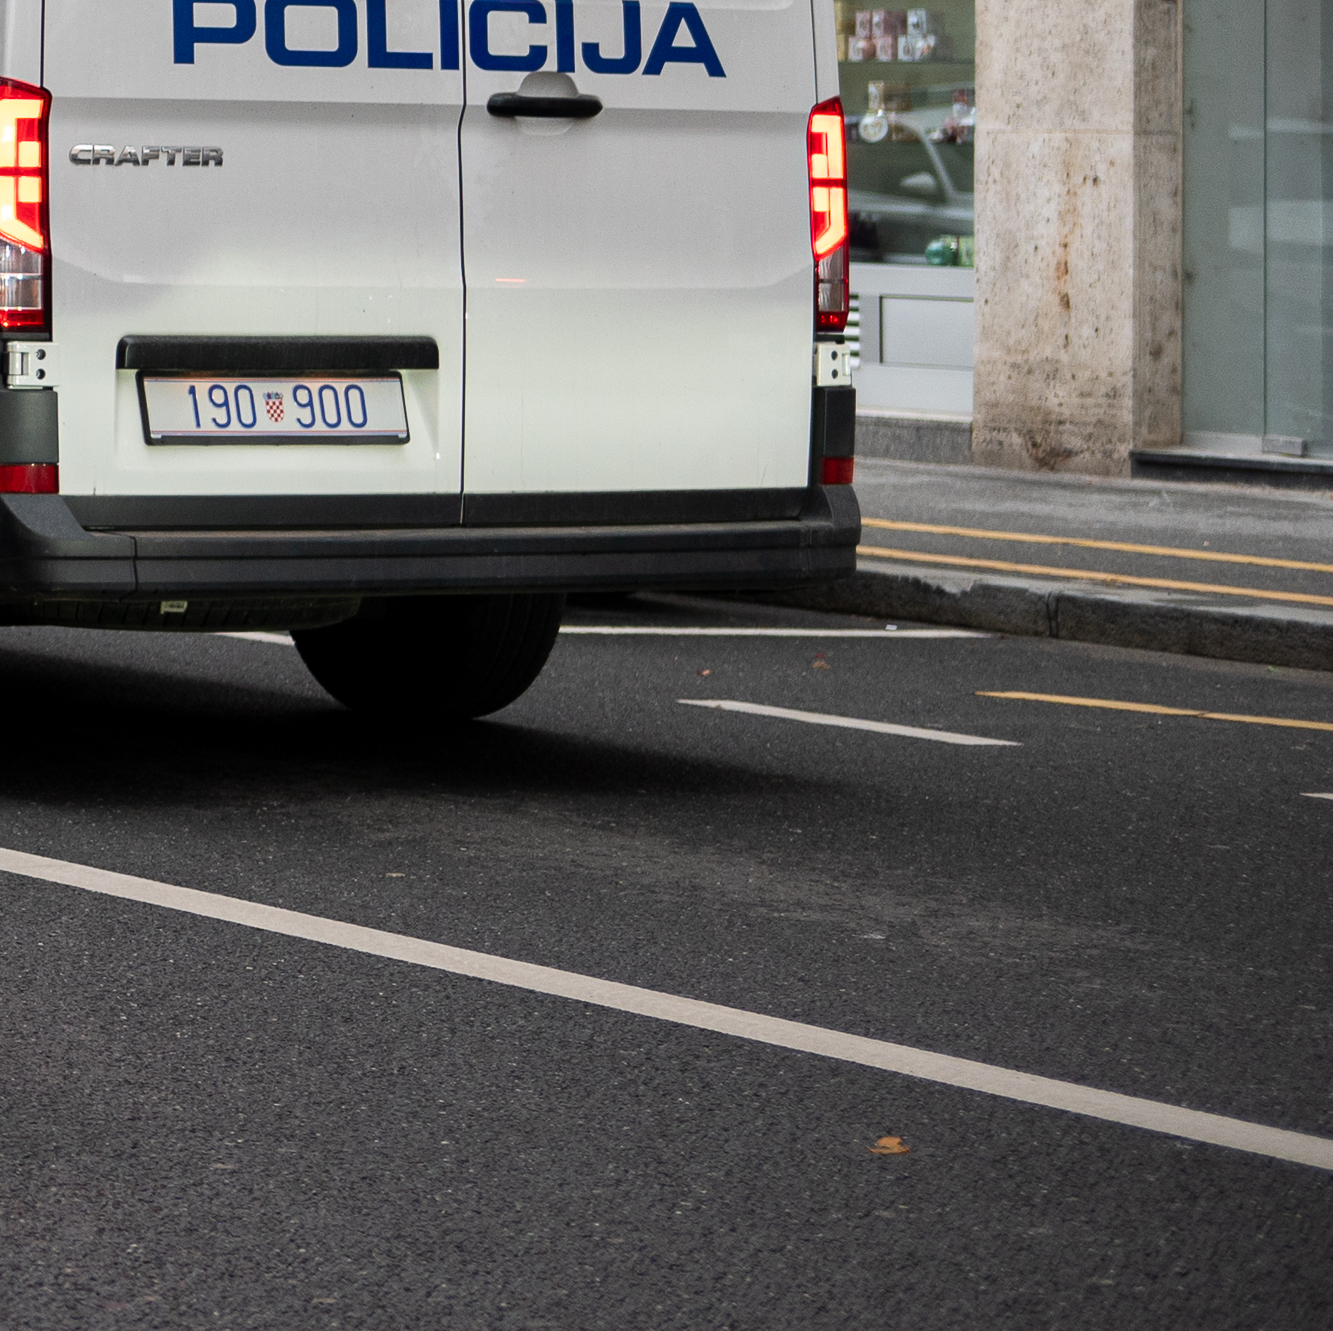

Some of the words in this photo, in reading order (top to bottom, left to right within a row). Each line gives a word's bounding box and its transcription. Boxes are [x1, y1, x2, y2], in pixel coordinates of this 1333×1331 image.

[69, 144, 224, 167] CRAFTER
[188, 384, 257, 429] 190
[292, 384, 368, 429] 900
